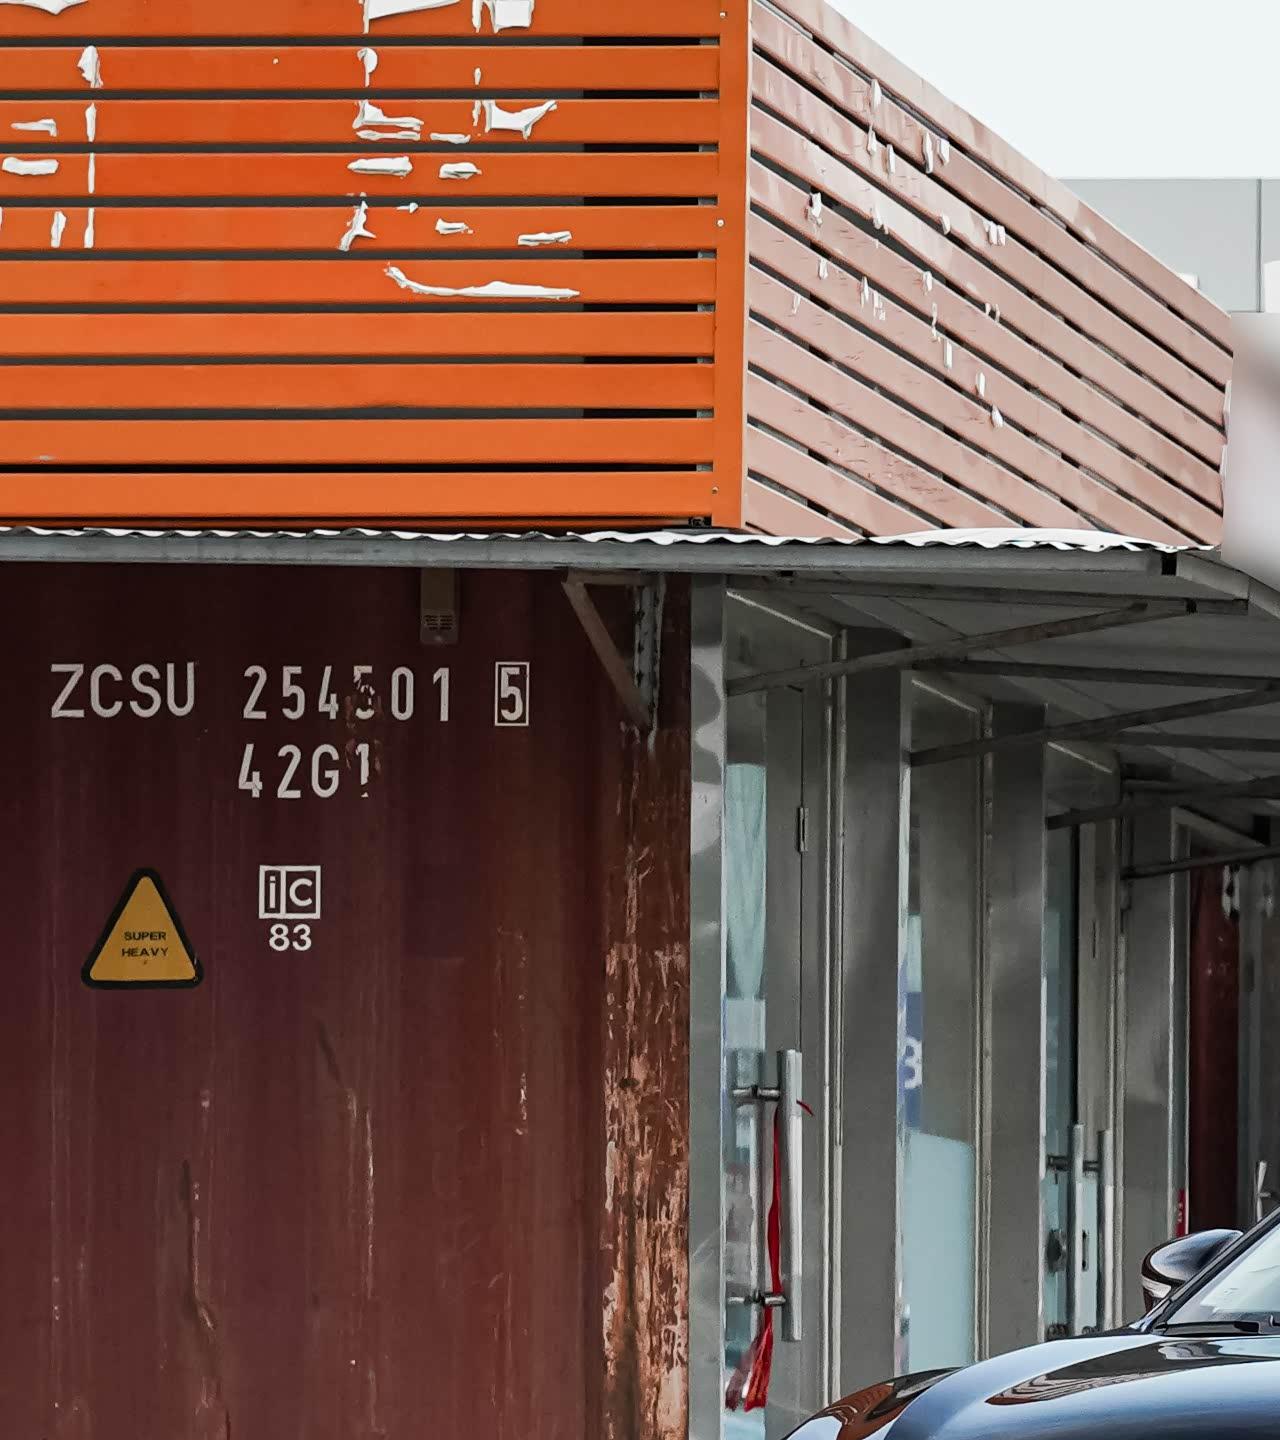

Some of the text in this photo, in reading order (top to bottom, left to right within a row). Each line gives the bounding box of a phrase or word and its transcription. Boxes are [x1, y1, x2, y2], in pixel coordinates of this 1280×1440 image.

[50, 663, 523, 722] ZCSU 254501 5
[238, 743, 370, 799] 42G1
[123, 930, 167, 941] SUPER
[268, 923, 313, 952] 83
[121, 947, 169, 957] HEAVY
